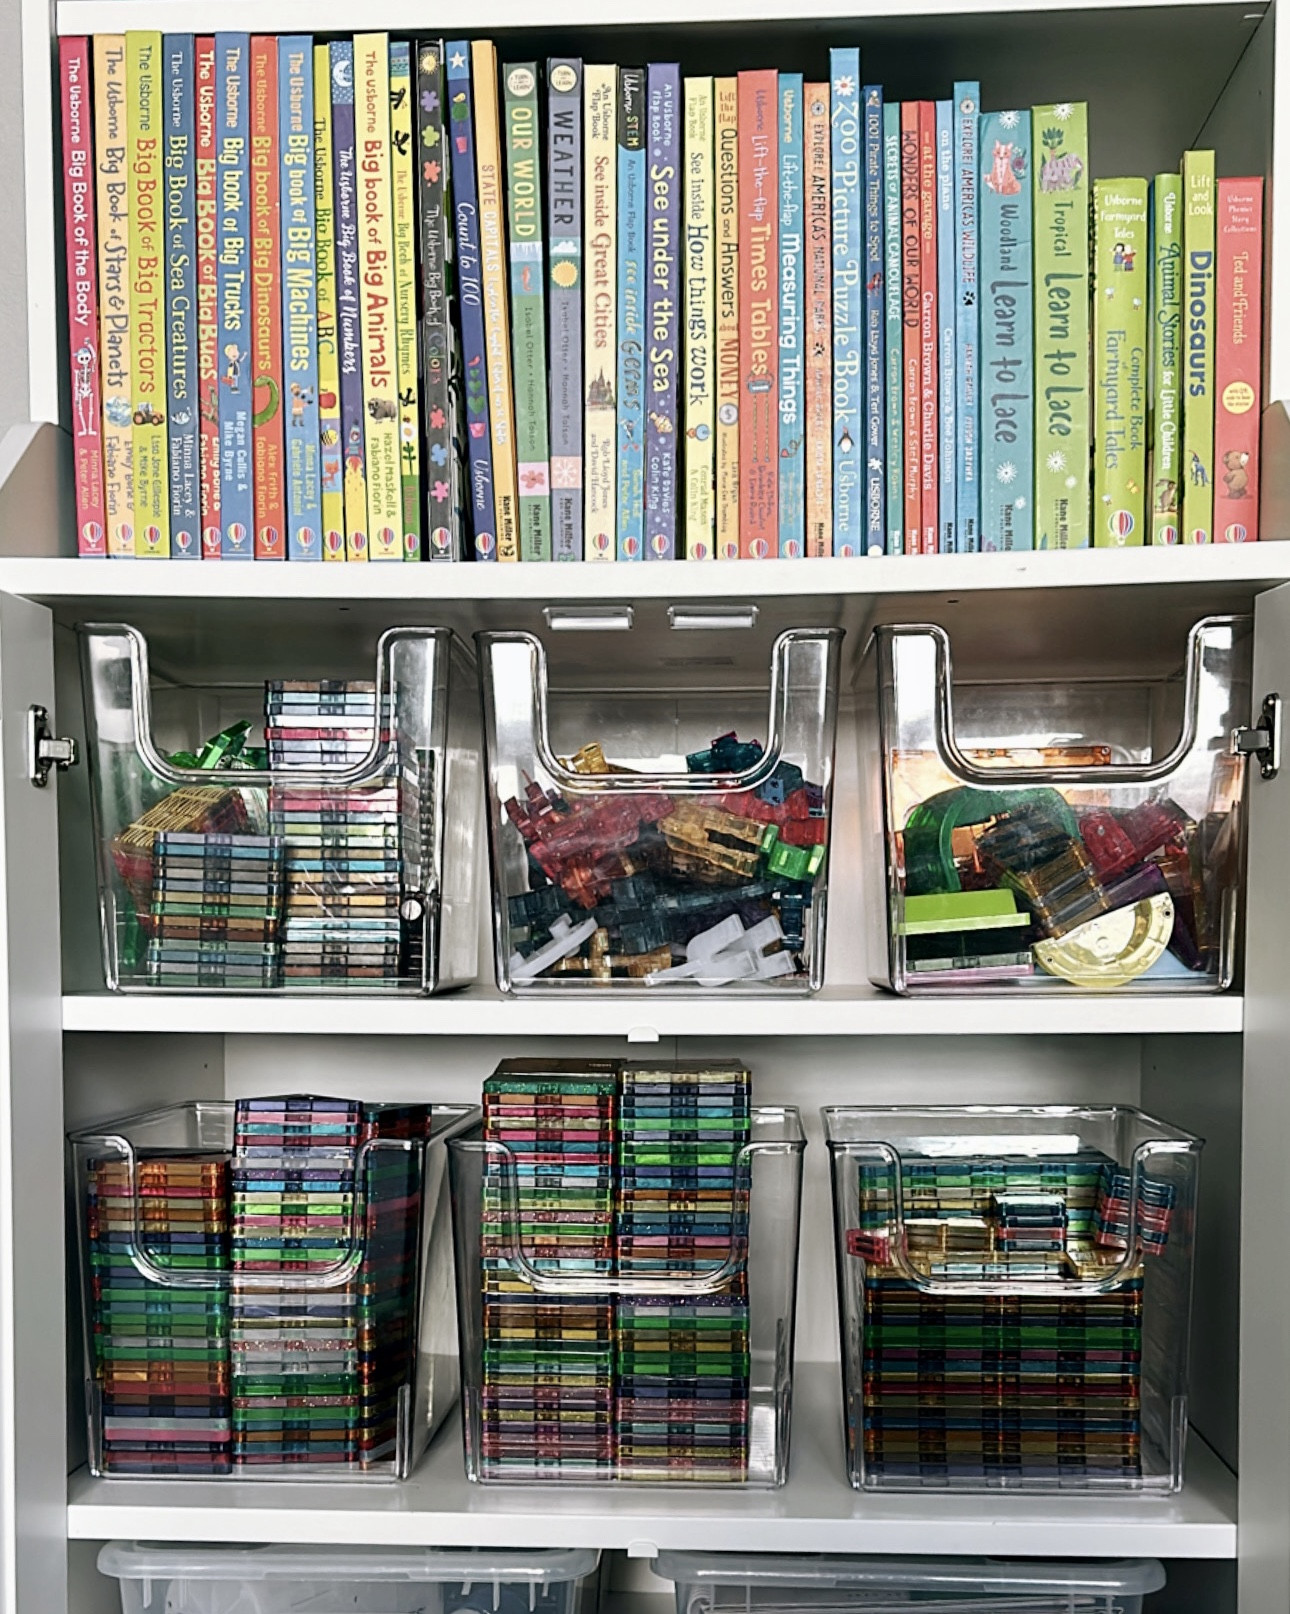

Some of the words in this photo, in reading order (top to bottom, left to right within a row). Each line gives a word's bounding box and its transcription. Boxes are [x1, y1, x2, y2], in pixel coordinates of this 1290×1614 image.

[68, 57, 81, 83] The
[106, 47, 123, 75] The
[171, 52, 183, 75] The
[227, 48, 241, 73] The
[256, 54, 267, 79] The
[290, 52, 303, 75] The
[171, 78, 183, 128] Usborne
[227, 76, 241, 129] Usborne
[256, 81, 267, 133] Usborne
[290, 77, 305, 131] Usborne
[590, 90, 601, 112] Flap
[601, 85, 613, 100] An
[650, 90, 662, 112] Flap
[663, 84, 673, 99] An
[69, 86, 81, 143] Usborne
[107, 82, 122, 139] Usborne
[512, 107, 533, 150] OUR
[592, 113, 602, 140] Book
[602, 102, 612, 141] Usborne
[651, 114, 662, 142] Book
[663, 101, 673, 147] Usborne
[783, 89, 796, 144] Usborne
[830, 101, 859, 155] Zoo
[869, 114, 880, 139] 1001
[315, 120, 328, 145] The
[626, 115, 640, 147] STEM
[941, 129, 951, 147] on
[69, 150, 87, 178] Big
[100, 147, 126, 174] Big
[166, 135, 188, 168] Big
[219, 138, 245, 164] Big
[253, 136, 272, 167] Big
[284, 134, 309, 166] Big
[340, 147, 354, 169] The
[554, 111, 574, 225] WEATHER
[690, 152, 704, 175] See
[869, 143, 880, 176] Pirate
[902, 131, 915, 201] WONDERS
[923, 145, 934, 161] at
[941, 149, 953, 173] the
[315, 148, 328, 201] Usborne
[481, 165, 496, 207] STATE
[594, 156, 611, 182] See
[719, 127, 738, 215] Questions
[923, 163, 935, 188] the
[1191, 175, 1210, 188] Lift
[72, 182, 87, 224] Book
[107, 182, 128, 222] Book
[168, 175, 189, 230] Book
[223, 171, 245, 212] book
[256, 172, 272, 217] book
[289, 170, 308, 207] book
[340, 171, 355, 219] Usborne
[513, 160, 536, 236] WORLD
[594, 185, 611, 227] inside
[651, 166, 675, 211] See
[691, 179, 704, 220] inside
[780, 153, 799, 226] Lift-the-flap
[868, 180, 880, 217] Things
[939, 174, 952, 211] plane
[1192, 191, 1209, 202] and
[223, 218, 238, 232] of
[258, 219, 270, 234] of
[292, 209, 307, 224] of
[316, 208, 332, 235] Big
[458, 203, 475, 250] Count
[834, 162, 858, 257] Picture
[869, 221, 880, 232] to
[903, 207, 915, 227] OF
[921, 191, 934, 240] garage
[1162, 192, 1176, 234] Usborne
[1188, 203, 1213, 216] Look
[75, 227, 87, 245] of
[111, 229, 122, 241] of
[173, 234, 186, 249] of
[286, 227, 312, 263] Big
[337, 223, 356, 248] Big
[484, 211, 499, 272] CAPITALS
[688, 223, 709, 271] How
[722, 219, 733, 238] and
[999, 203, 1019, 272] Woodland
[1048, 200, 1074, 258] Tropical
[75, 250, 89, 276] the
[105, 241, 128, 292] Stars
[219, 238, 245, 266] Big
[254, 237, 273, 270] Big
[316, 239, 333, 283] Book
[461, 256, 477, 270] to
[590, 232, 613, 288] Great
[652, 217, 674, 290] under
[868, 235, 880, 262] Spot
[903, 234, 916, 267] OUR
[1232, 252, 1249, 277] Ted
[170, 254, 189, 291] Sea
[342, 251, 357, 286] Book
[720, 241, 738, 318] Answers
[1157, 242, 1181, 306] Animal
[75, 282, 92, 326] Body
[109, 296, 122, 311] &
[224, 271, 246, 330] Trucks
[317, 287, 331, 301] of
[343, 290, 357, 302] of
[462, 276, 480, 306] 100
[778, 233, 801, 349] Measuring
[833, 260, 860, 347] Puzzle
[903, 274, 918, 329] WORLD
[1045, 272, 1084, 339] Learn
[1233, 277, 1248, 301] and
[254, 273, 273, 371] Dinosaurs
[287, 268, 315, 372] Machines
[593, 291, 613, 349] Cities
[653, 297, 674, 341] the
[688, 276, 709, 342] things
[923, 290, 934, 337] Carron
[991, 281, 1029, 347] Learn
[1190, 251, 1213, 398] Dinosaurs
[1232, 300, 1249, 345] Friends
[106, 313, 129, 387] Planets
[171, 296, 192, 400] Creatures
[317, 311, 335, 355] ABC
[341, 306, 358, 375] Numbers
[1157, 309, 1181, 368] Stories
[650, 346, 674, 393] Sea
[689, 347, 709, 406] work
[719, 338, 739, 401] MONEY
[923, 339, 935, 385] Brown
[988, 356, 1023, 384] to
[1043, 349, 1077, 377] to
[1100, 329, 1127, 421] Farmyard
[1126, 346, 1144, 412] Complete
[1162, 370, 1174, 386] for
[778, 354, 801, 425] Things
[833, 350, 860, 424] Book
[923, 388, 935, 399] &
[1161, 388, 1176, 420] Little
[924, 401, 936, 449] Charlie
[991, 393, 1030, 444] Lace
[1045, 386, 1085, 438] Lace
[223, 421, 235, 446] Mike
[1105, 430, 1126, 470] Tales
[1130, 415, 1144, 451] Book
[1161, 420, 1176, 470] Children
[171, 437, 183, 481] Fabiano
[183, 434, 194, 470] Minna
[220, 450, 235, 481] Byrne
[182, 473, 195, 500] Lacey
[474, 460, 490, 512] Usborne
[923, 453, 935, 490] Davis
[172, 485, 184, 516] Fiorin
[184, 508, 195, 518] &
[503, 495, 512, 514] Kane
[563, 498, 574, 520] Kane
[838, 460, 858, 532] Usborne
[870, 477, 880, 532] USBORNE
[504, 518, 514, 541] Miller
[532, 504, 542, 526] Kane
[533, 529, 543, 556] Miller
[564, 523, 575, 550] Miller
